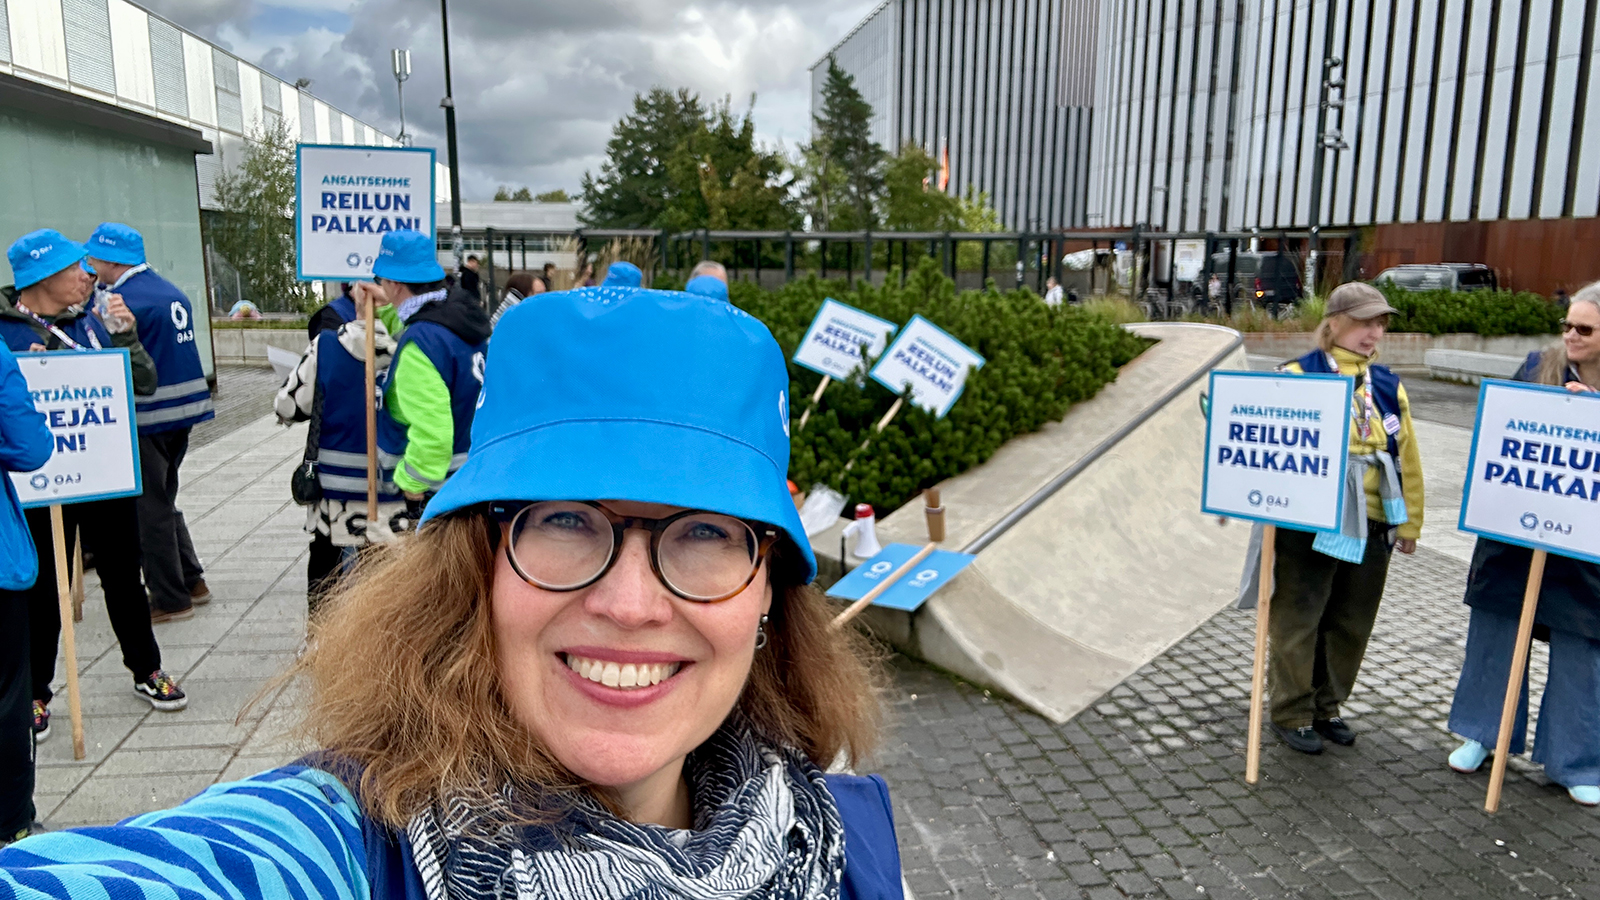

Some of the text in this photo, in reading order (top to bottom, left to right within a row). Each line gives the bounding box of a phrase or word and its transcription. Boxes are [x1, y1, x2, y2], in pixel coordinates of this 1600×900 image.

[321, 175, 411, 188] ANSAITSEMME
[321, 191, 411, 212] REILUN
[311, 214, 421, 233] PALKAN!
[177, 329, 194, 344] OAJ
[813, 332, 862, 358] PALKA
[32, 384, 114, 403] RTJÄNAR
[45, 401, 117, 429] EJÄL
[1230, 404, 1322, 422] ANSAITSEMME
[1228, 421, 1320, 450] REILUN
[1505, 418, 1600, 443] ANSAITSEM
[55, 432, 87, 453] N!
[1217, 445, 1330, 477] PALKAN!
[54, 472, 82, 486] OAJ
[1483, 460, 1600, 502] PALKA
[1265, 494, 1290, 509] OAJ
[1543, 519, 1573, 535] OAJ
